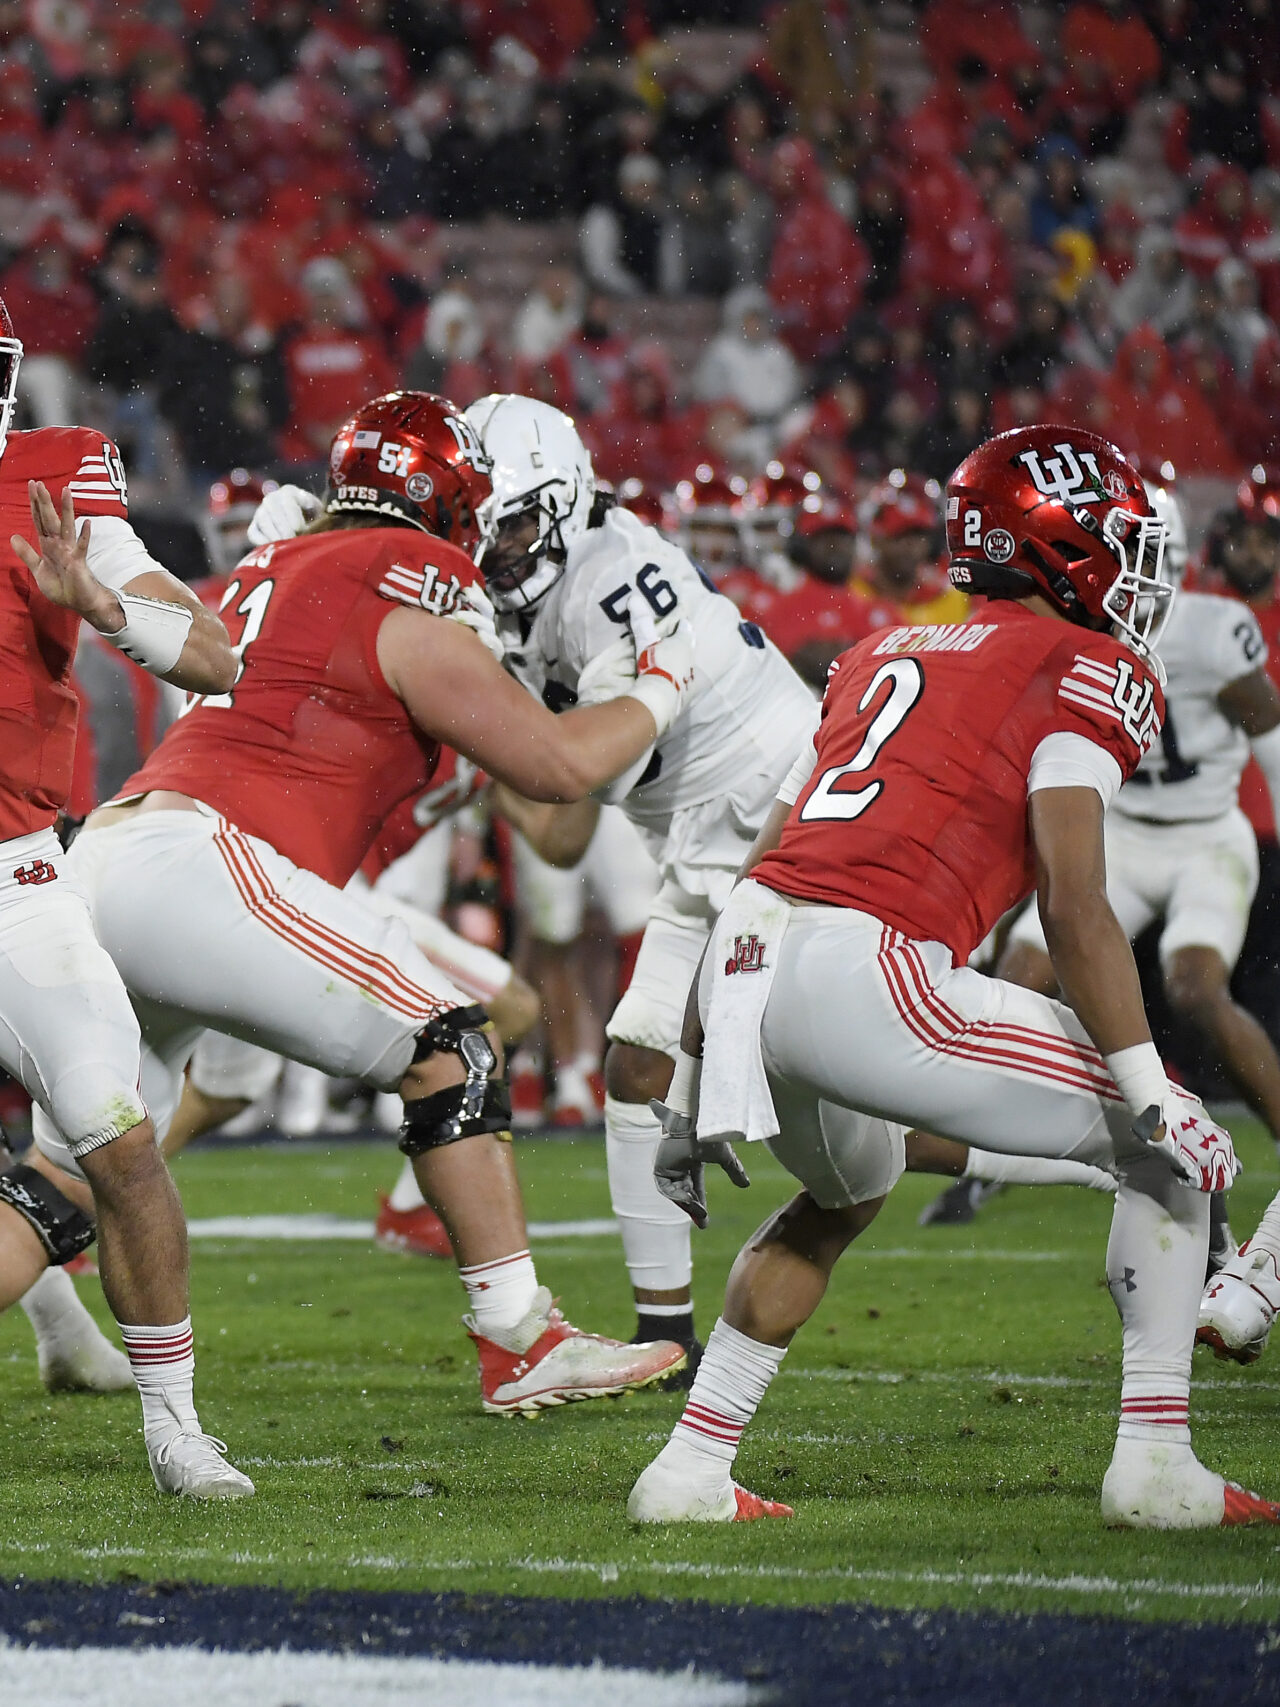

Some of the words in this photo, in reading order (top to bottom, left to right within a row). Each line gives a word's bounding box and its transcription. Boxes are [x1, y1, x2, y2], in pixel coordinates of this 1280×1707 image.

[378, 442, 412, 478] 51
[337, 486, 379, 501] UTES
[964, 509, 982, 546] 2
[947, 566, 973, 583] TES
[872, 624, 999, 655] BERNARD
[798, 656, 926, 824] 2
